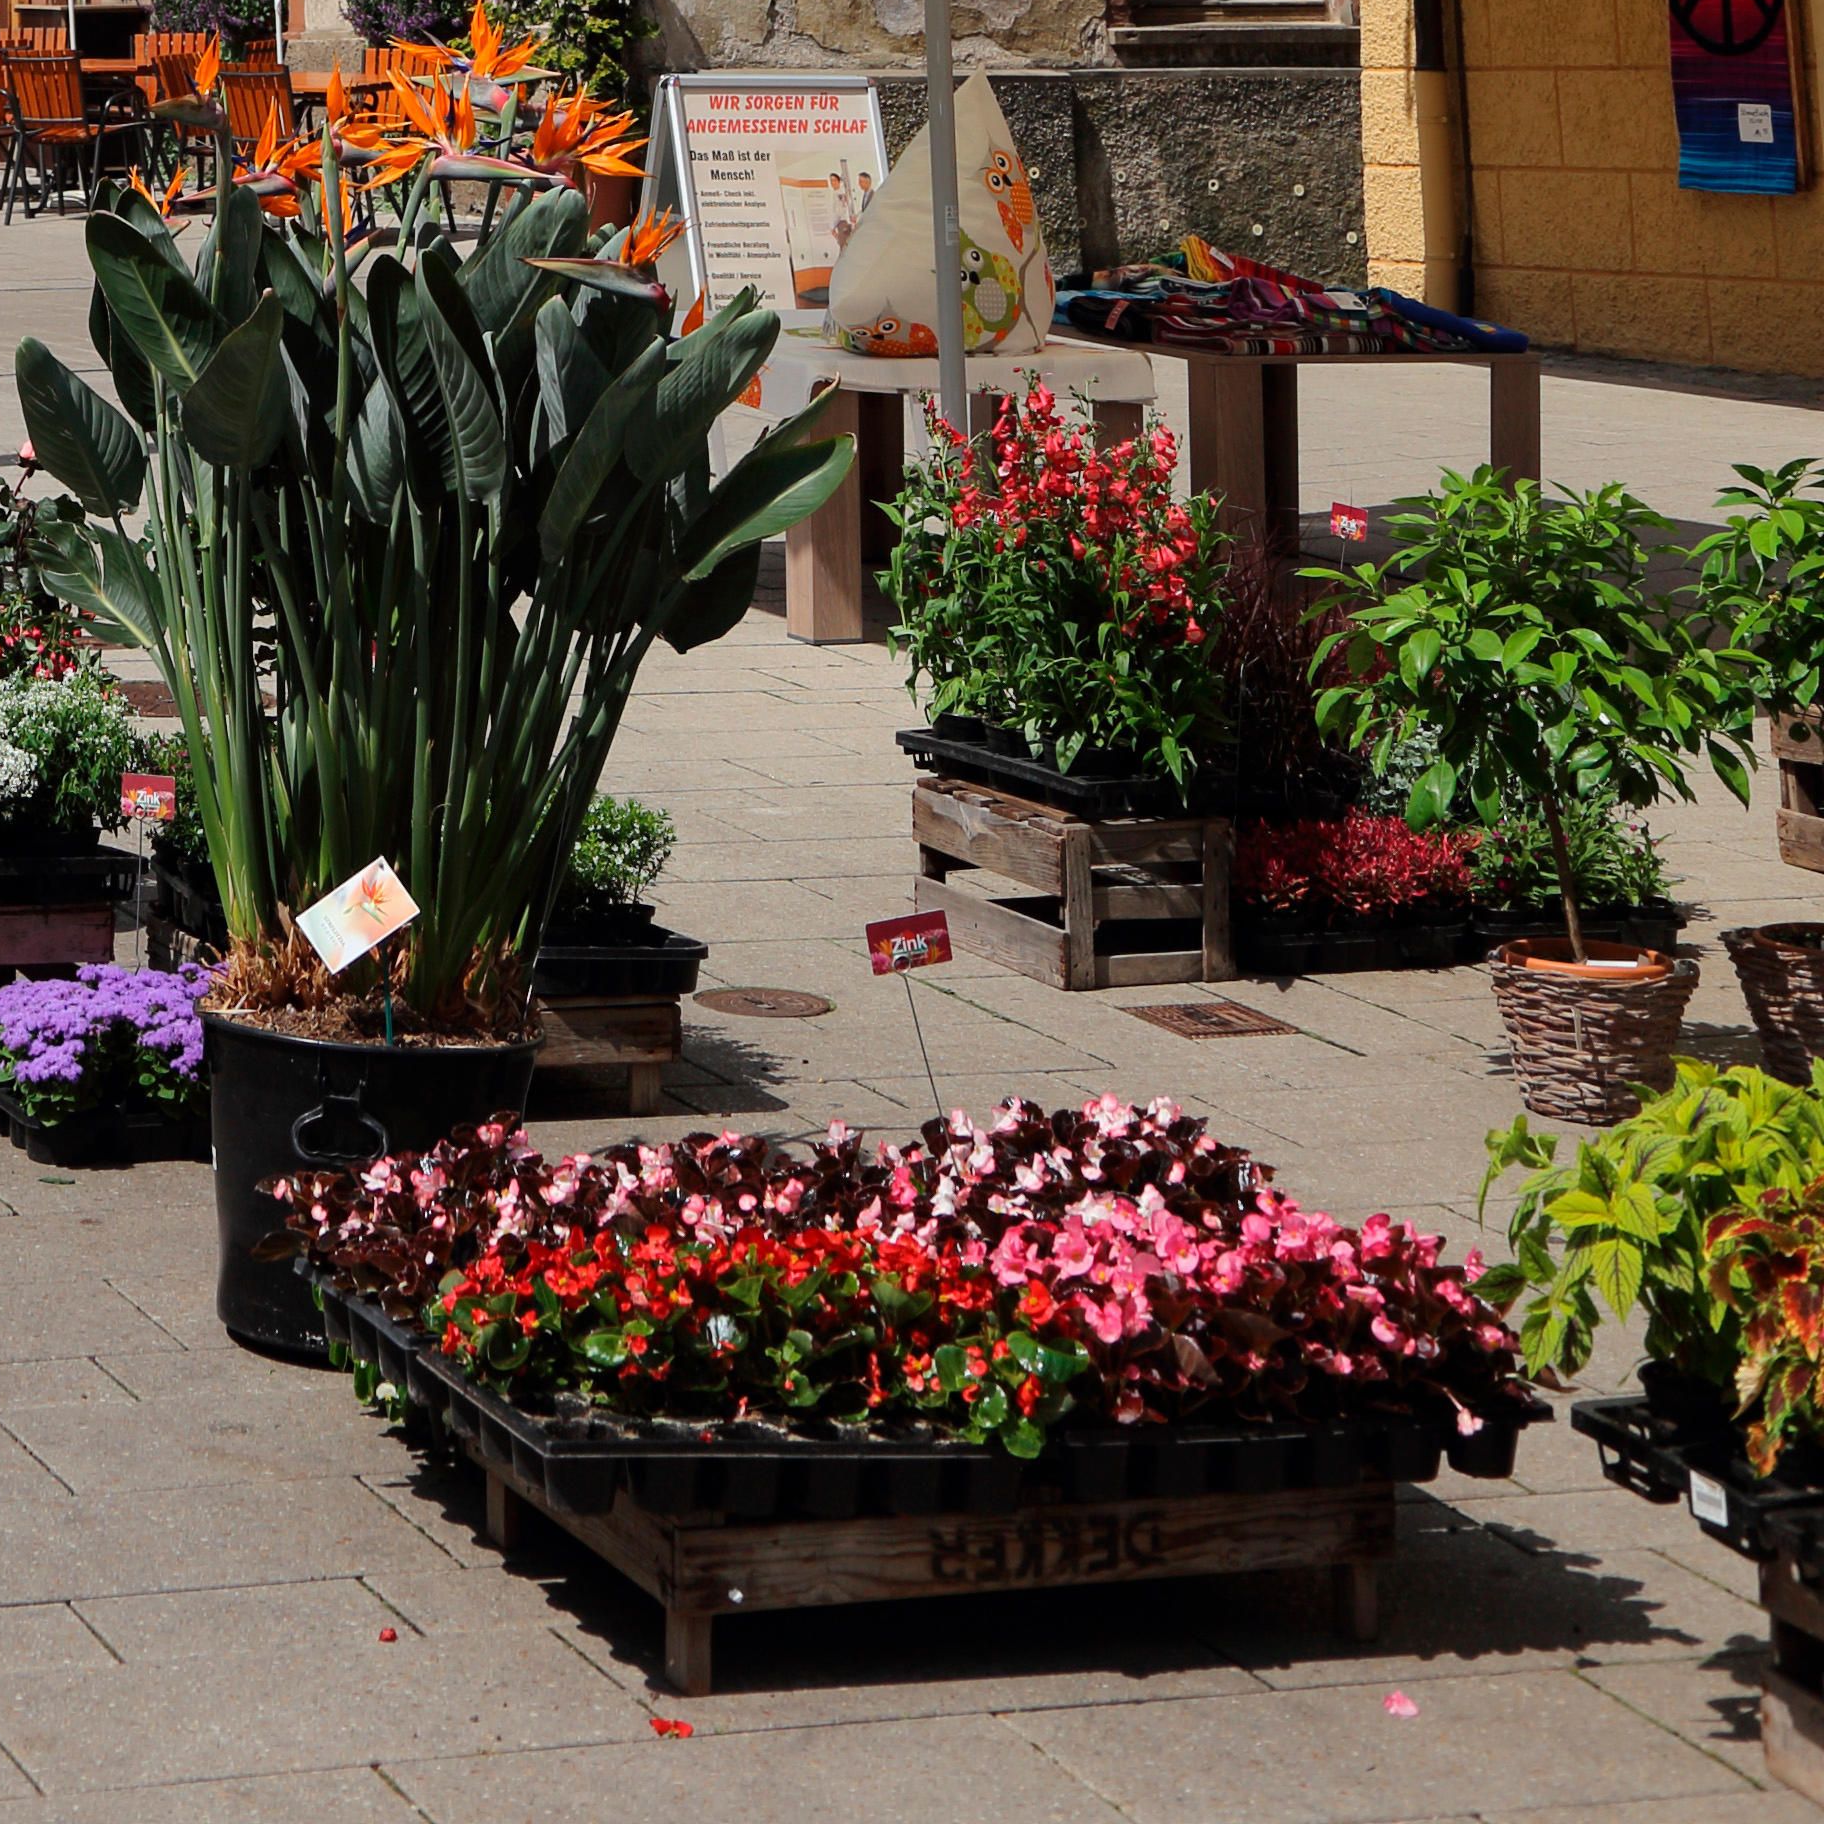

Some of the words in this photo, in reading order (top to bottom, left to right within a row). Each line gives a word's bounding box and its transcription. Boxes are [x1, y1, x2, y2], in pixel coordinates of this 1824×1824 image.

[709, 95, 740, 111] WIR
[745, 95, 805, 111] SORGEN
[810, 92, 840, 111] FÜR
[686, 118, 809, 134] ANGEMESSENEN
[813, 119, 868, 134] SCHLAF
[689, 150, 709, 162] Das
[712, 150, 735, 162] Maß
[738, 150, 750, 162] ist
[754, 150, 771, 162] der
[710, 169, 755, 181] Mensch!
[137, 789, 161, 804] Zink
[891, 934, 928, 953] Zink
[929, 1510, 1168, 1583] DEKKER
